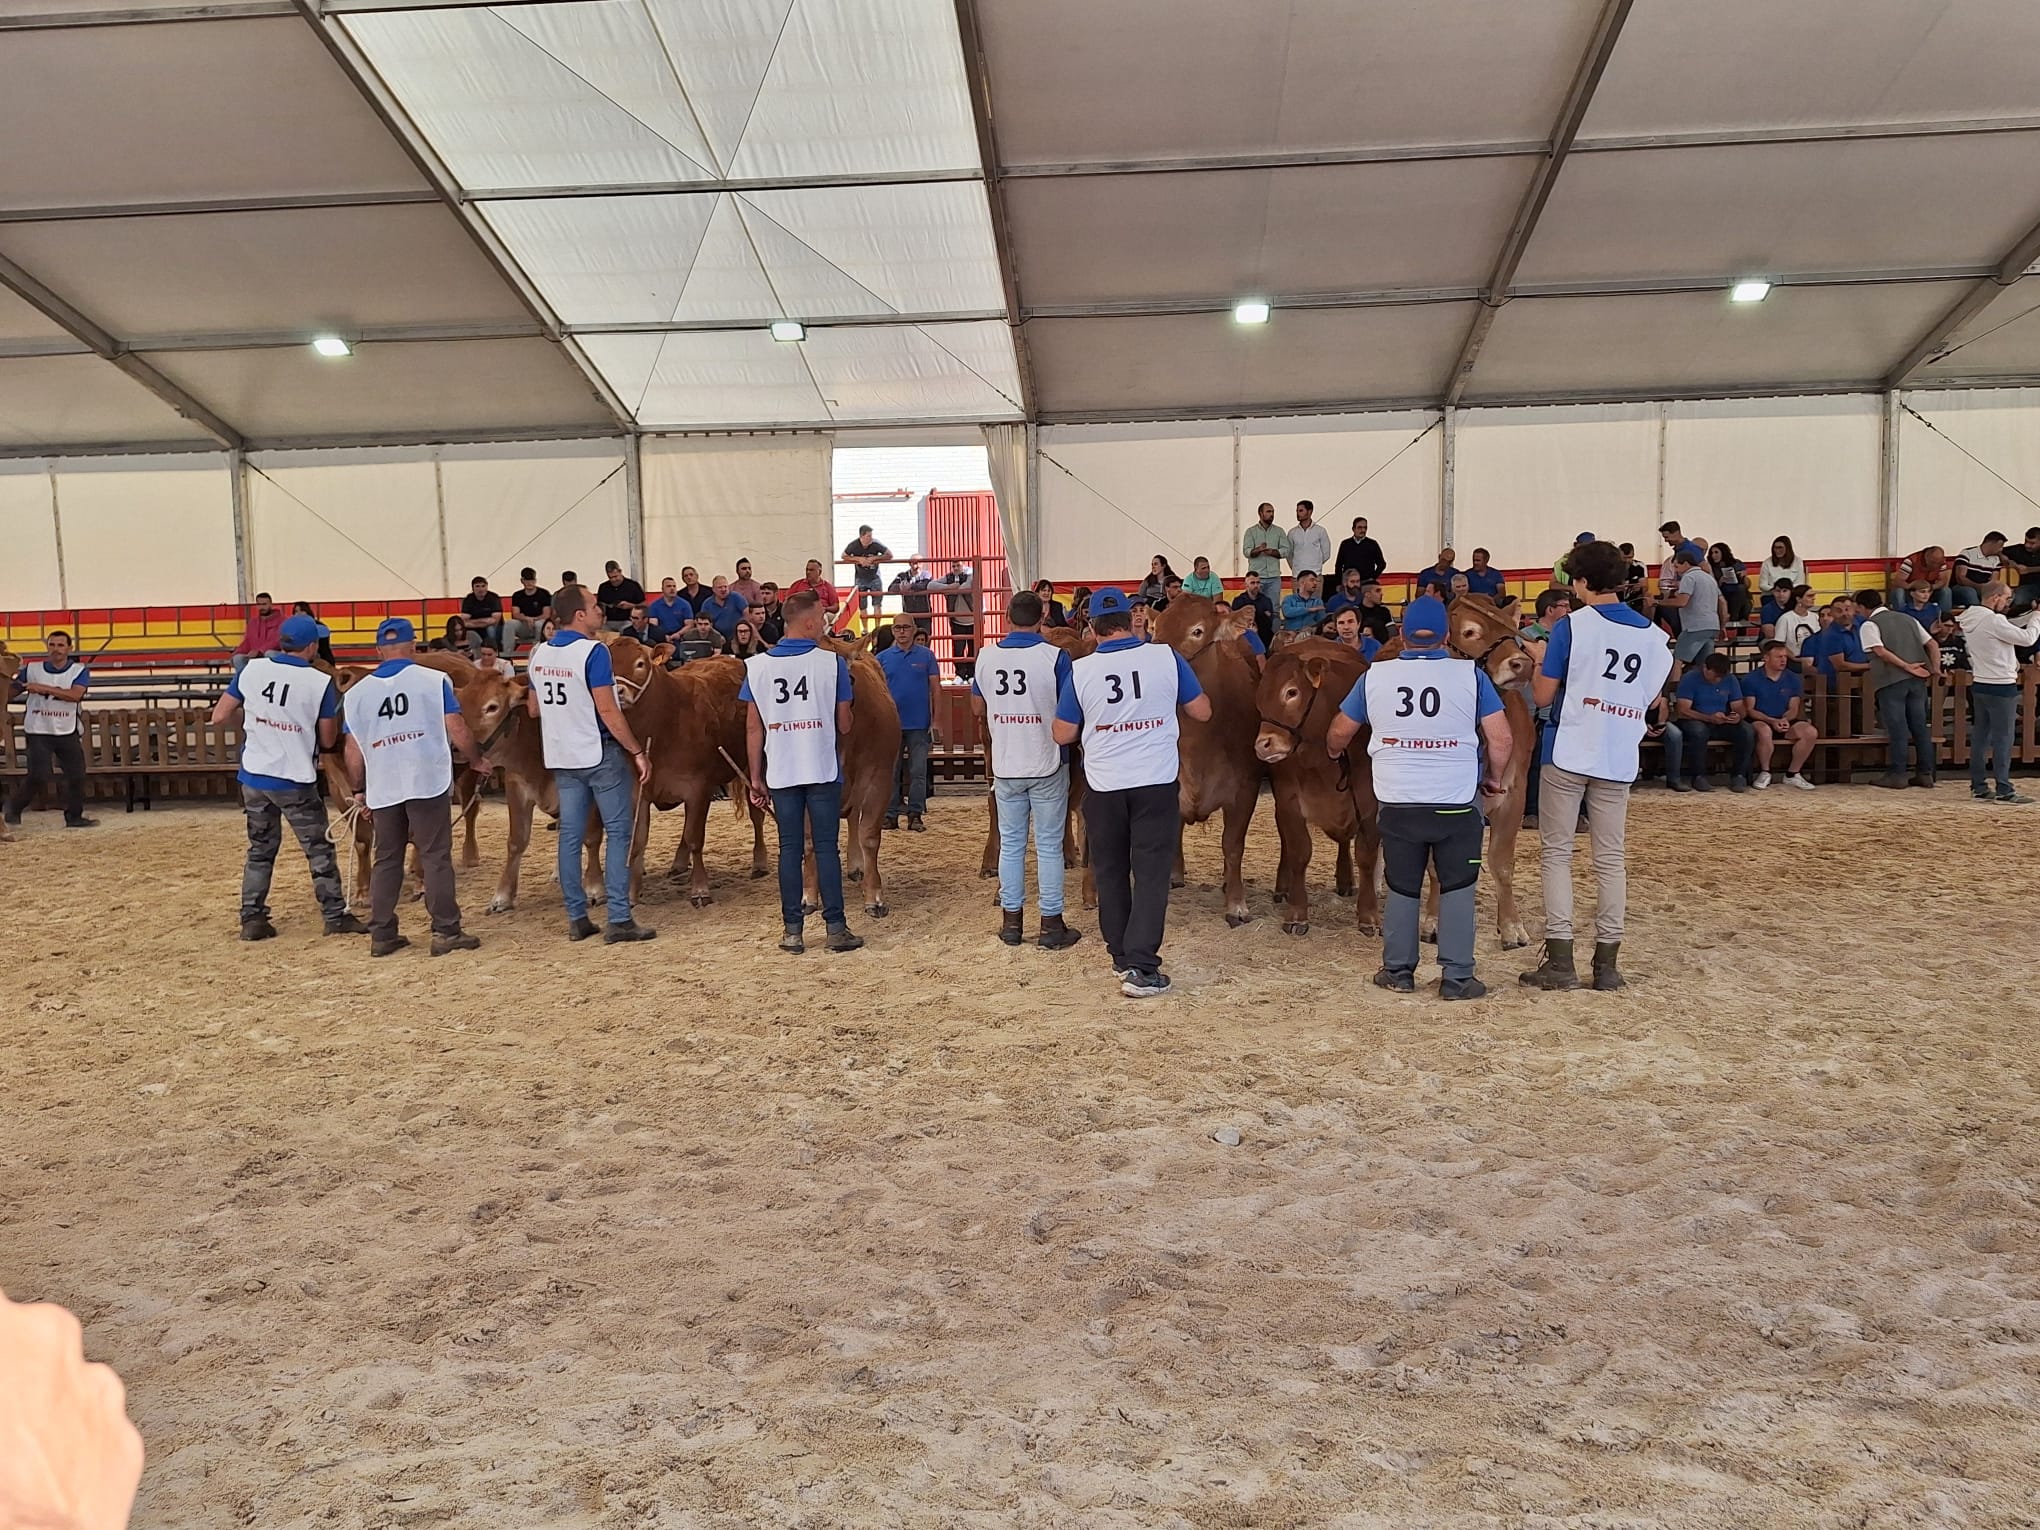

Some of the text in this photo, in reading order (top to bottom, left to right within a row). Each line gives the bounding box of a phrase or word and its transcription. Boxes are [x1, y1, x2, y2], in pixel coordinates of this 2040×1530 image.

[543, 668, 573, 678] LIMUSIN
[1601, 648, 1642, 683] 29
[261, 681, 290, 707] 41
[543, 682, 567, 705] 35
[774, 675, 808, 704] 34
[995, 669, 1027, 695] 33
[1105, 670, 1141, 704] 31
[378, 692, 409, 720] 40
[1395, 686, 1440, 717] 30
[783, 721, 823, 732] LIMUSIN
[1000, 715, 1042, 724] LIMUSIN
[1113, 719, 1164, 732] LIMUSIN
[1401, 740, 1458, 749] LIMUSIN
